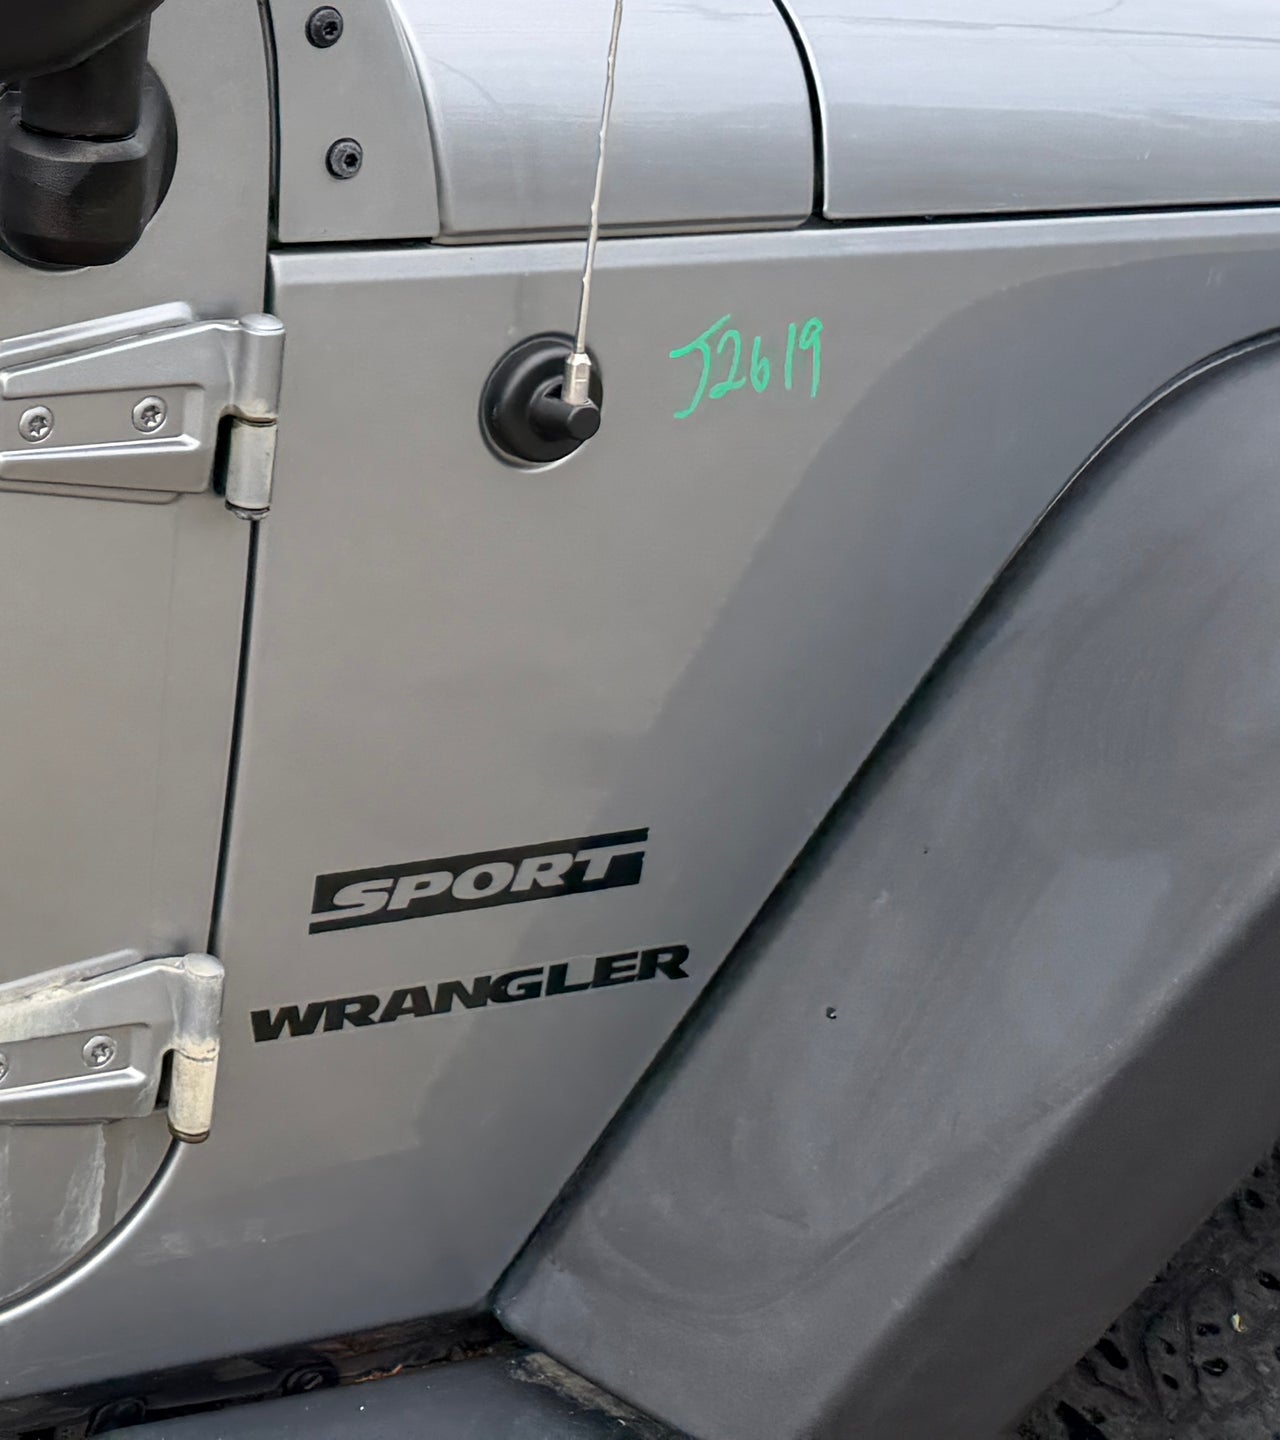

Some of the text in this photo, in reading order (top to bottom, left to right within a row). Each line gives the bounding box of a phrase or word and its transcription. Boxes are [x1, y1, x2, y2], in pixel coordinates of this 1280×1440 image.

[669, 313, 824, 419] J2619
[312, 846, 646, 925] SPORT
[250, 944, 690, 1043] WRANGLER
